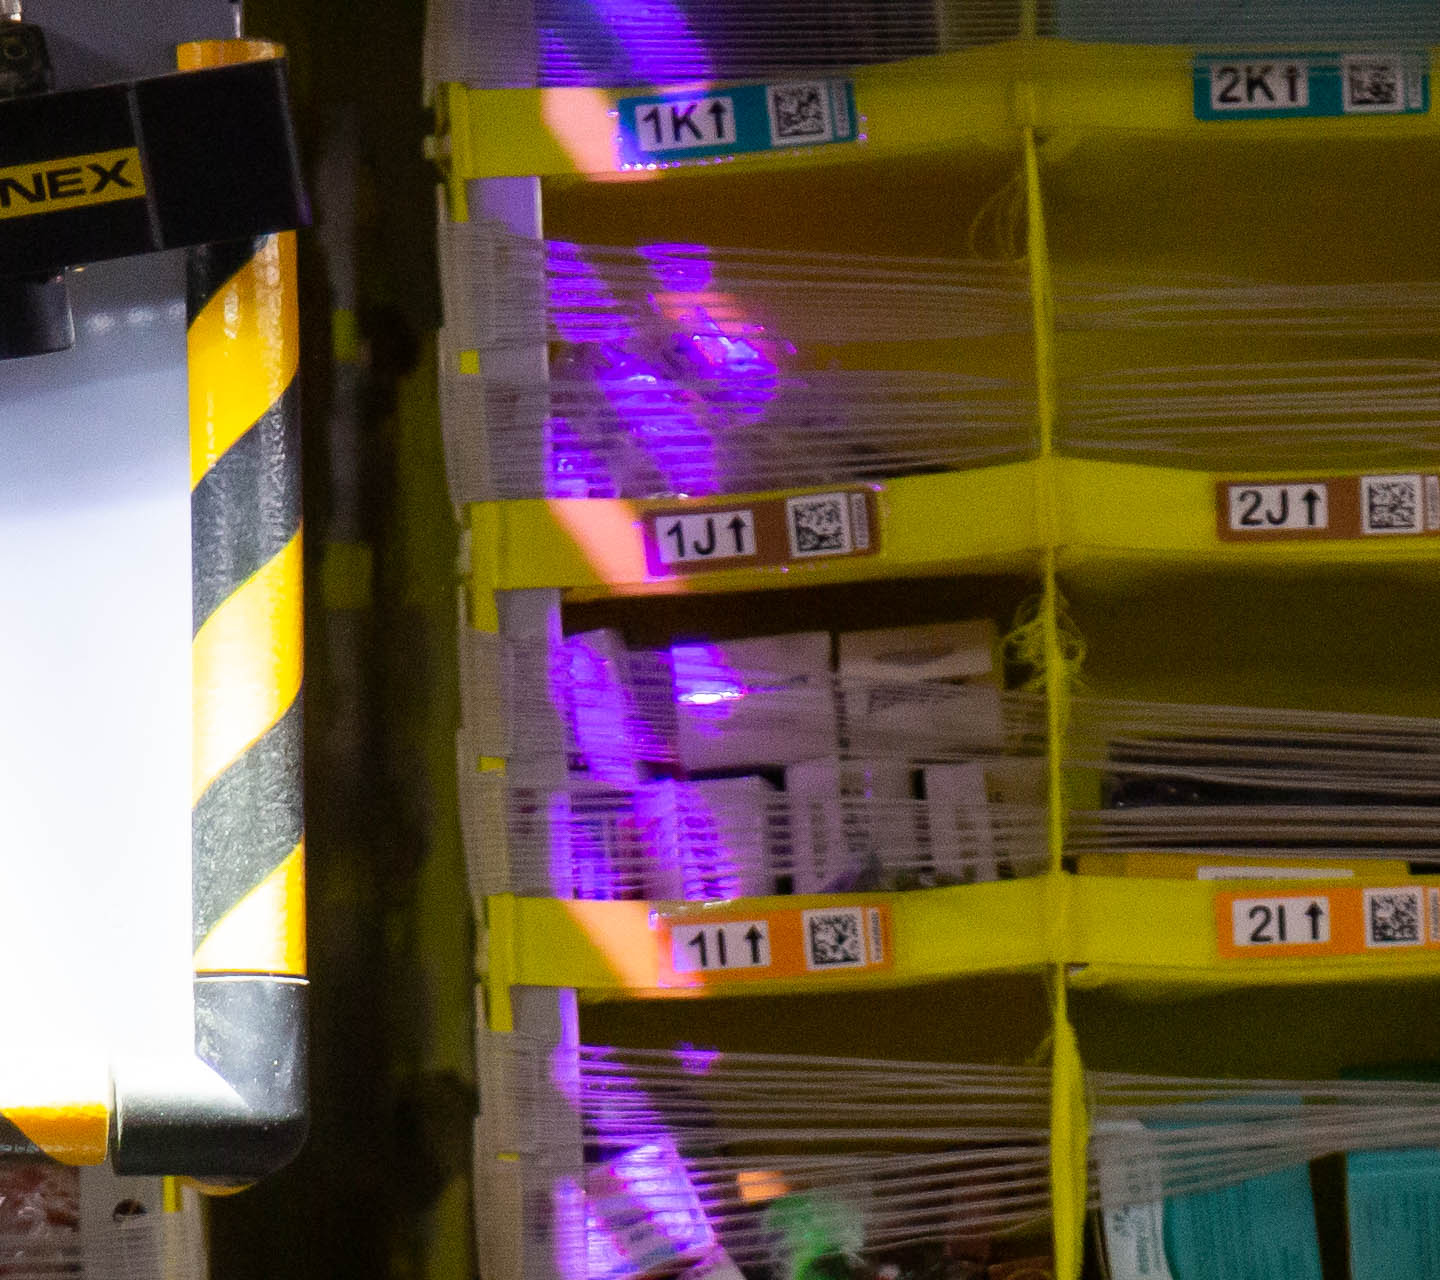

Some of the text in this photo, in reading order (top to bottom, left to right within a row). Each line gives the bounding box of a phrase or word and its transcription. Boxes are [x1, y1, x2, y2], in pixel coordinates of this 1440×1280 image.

[1217, 64, 1275, 104] 2K
[643, 104, 704, 143] 1K
[1238, 489, 1289, 527] 2J
[666, 518, 717, 558] 1J
[1248, 905, 1287, 944] 2I
[689, 929, 727, 967] 1I
